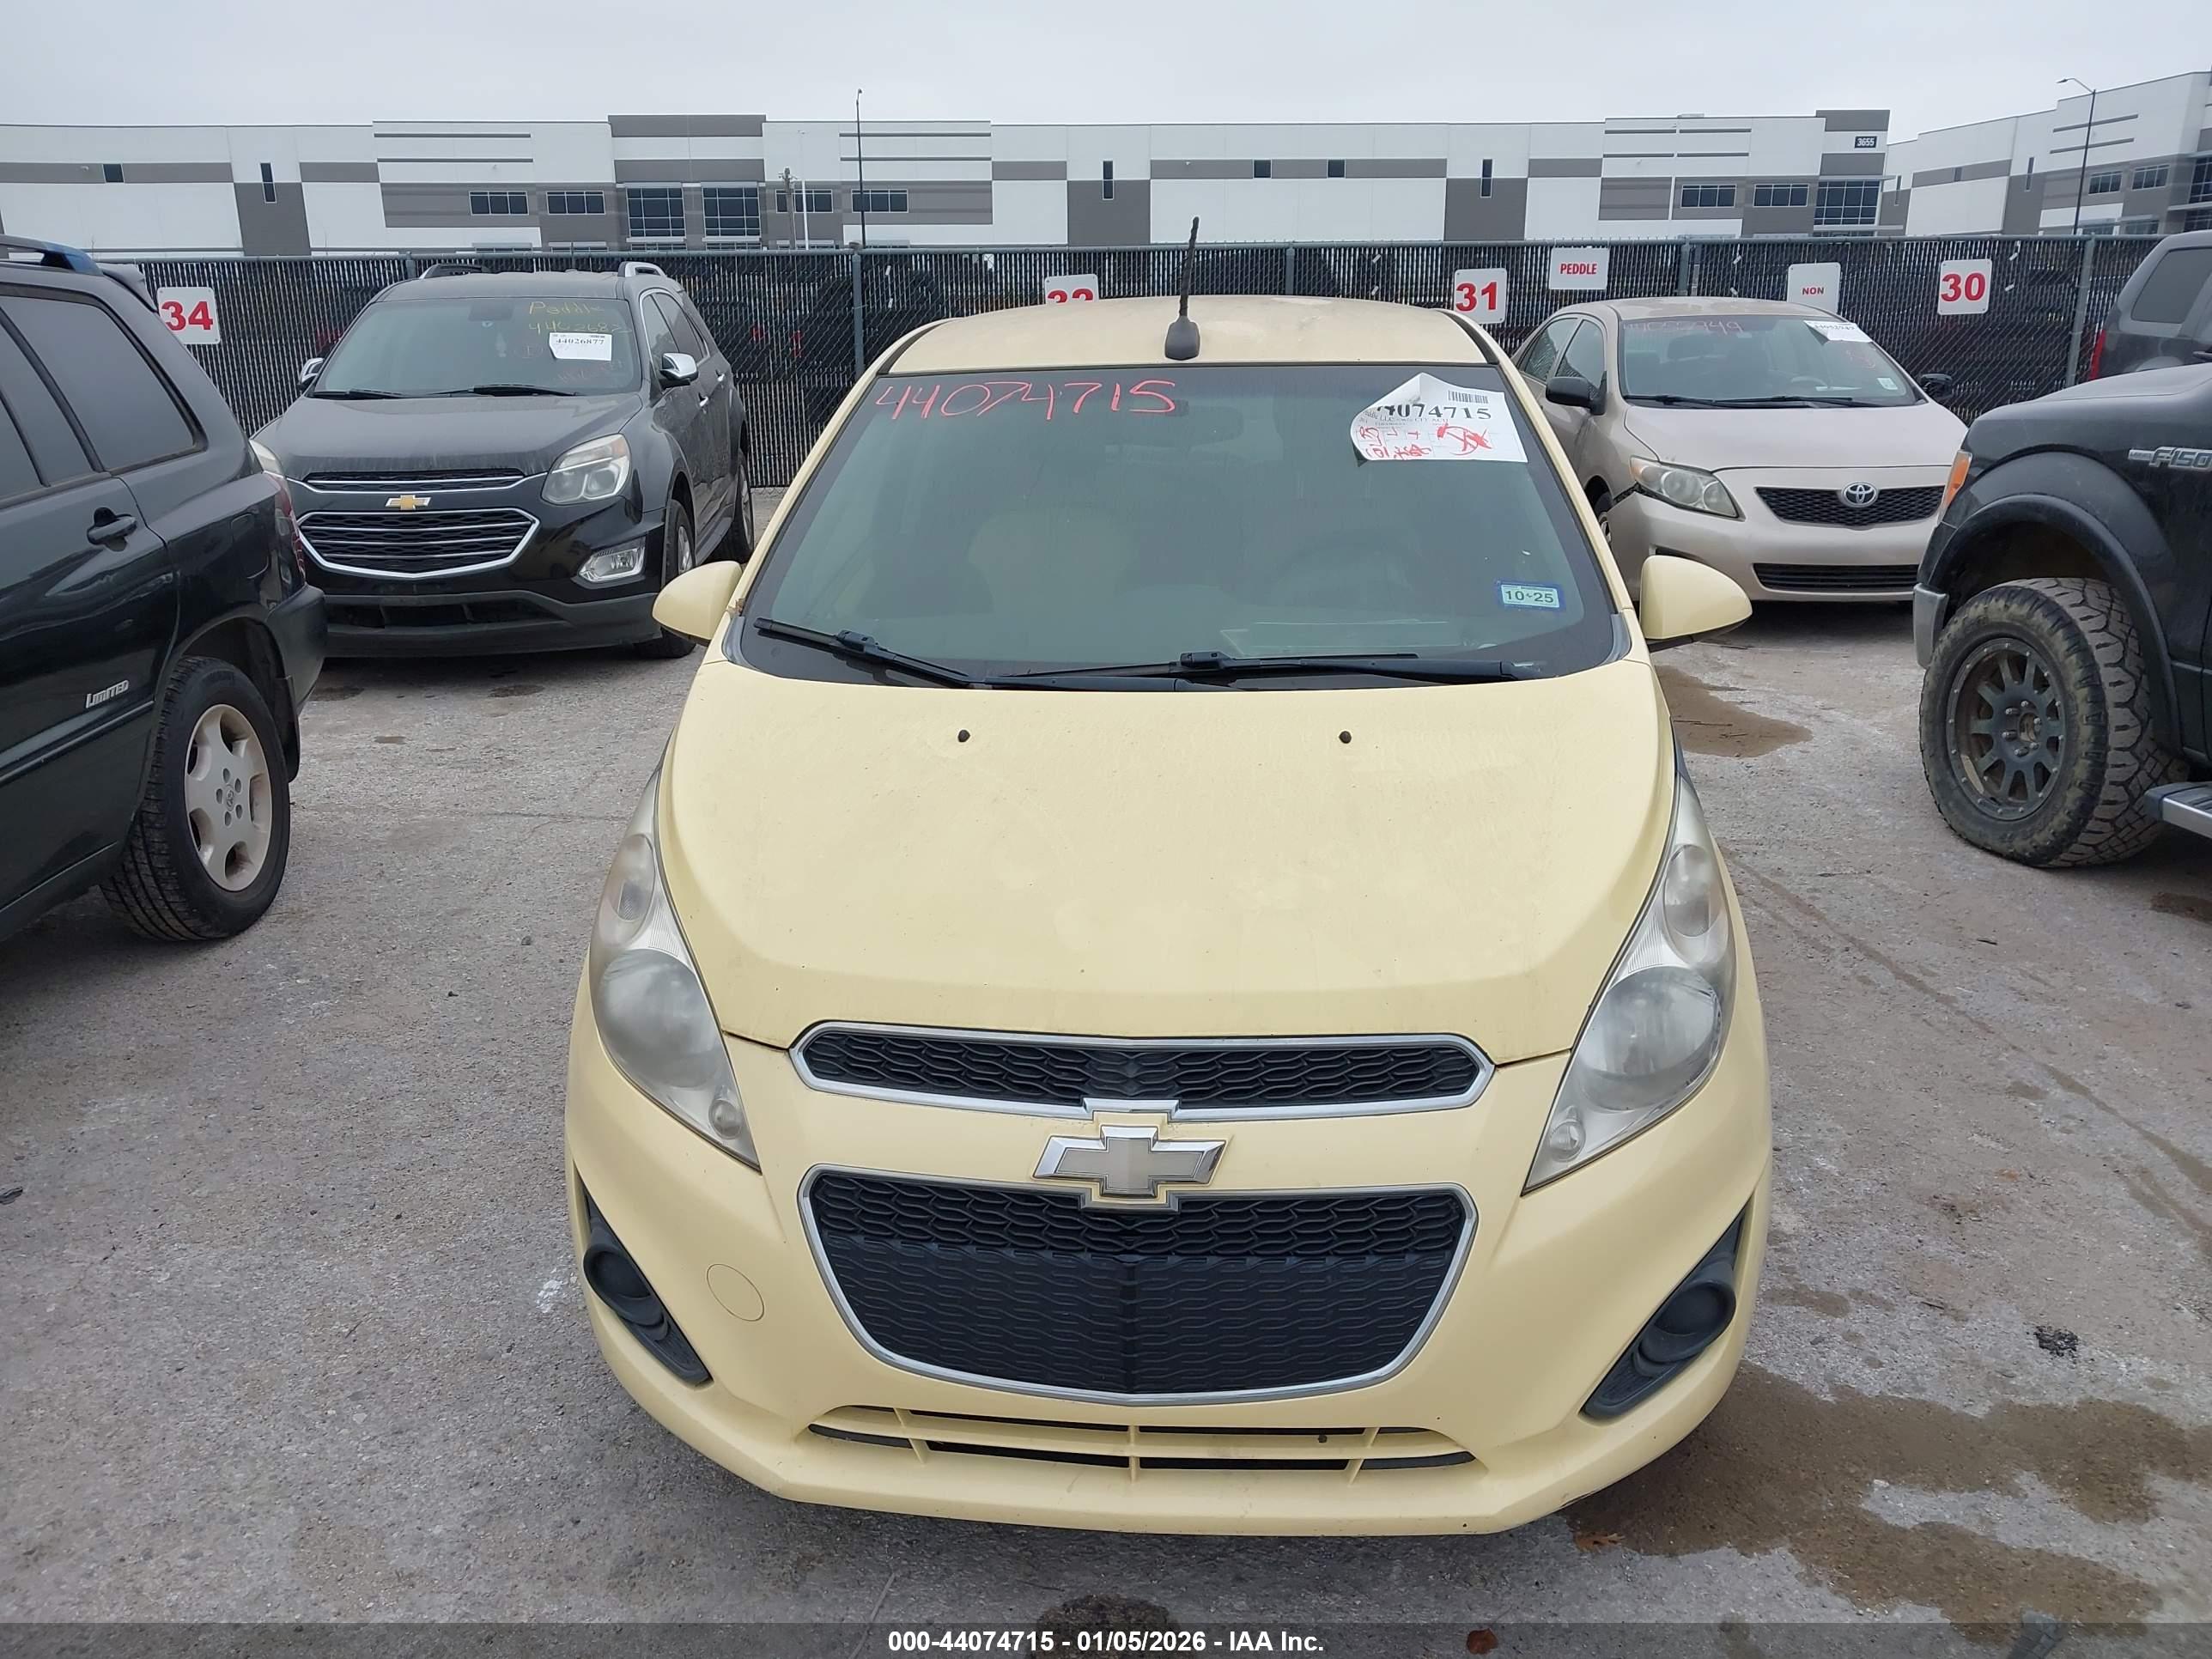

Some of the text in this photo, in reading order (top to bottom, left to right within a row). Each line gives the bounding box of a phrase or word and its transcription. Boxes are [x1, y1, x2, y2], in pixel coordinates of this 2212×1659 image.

[1856, 137, 1875, 147] 3655
[1559, 263, 1598, 275] PEDDLE
[1455, 281, 1498, 311] 31
[1802, 287, 1825, 295] NON
[1940, 272, 1986, 302] 30
[161, 301, 214, 331] 34
[875, 380, 1176, 420] 44074715
